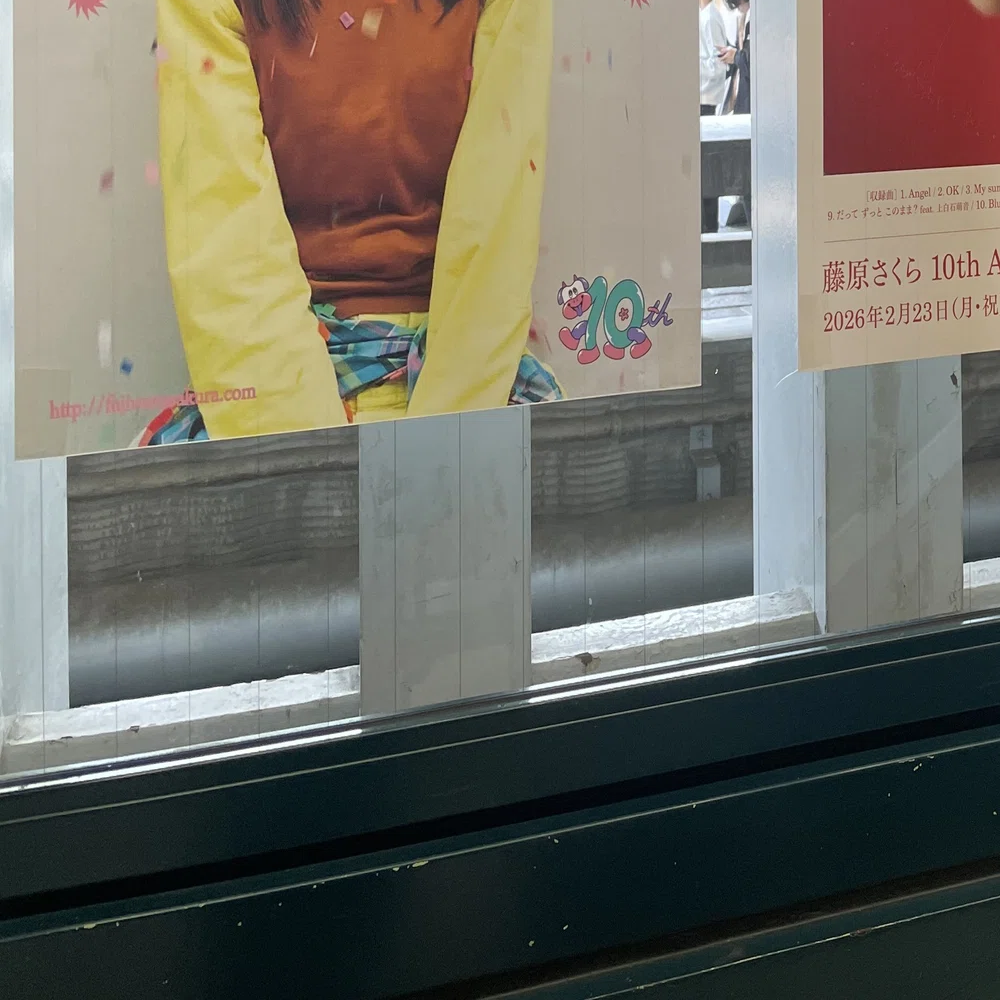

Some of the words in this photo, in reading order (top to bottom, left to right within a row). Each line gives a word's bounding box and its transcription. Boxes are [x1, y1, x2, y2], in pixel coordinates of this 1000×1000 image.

[909, 185, 931, 200] Angel
[946, 185, 960, 196] OK
[974, 184, 986, 196] My
[836, 208, 858, 221] だって
[861, 206, 882, 219] ずっと
[919, 204, 934, 214] feat.
[822, 256, 922, 294] 藤原さくら
[931, 251, 981, 281] 10th
